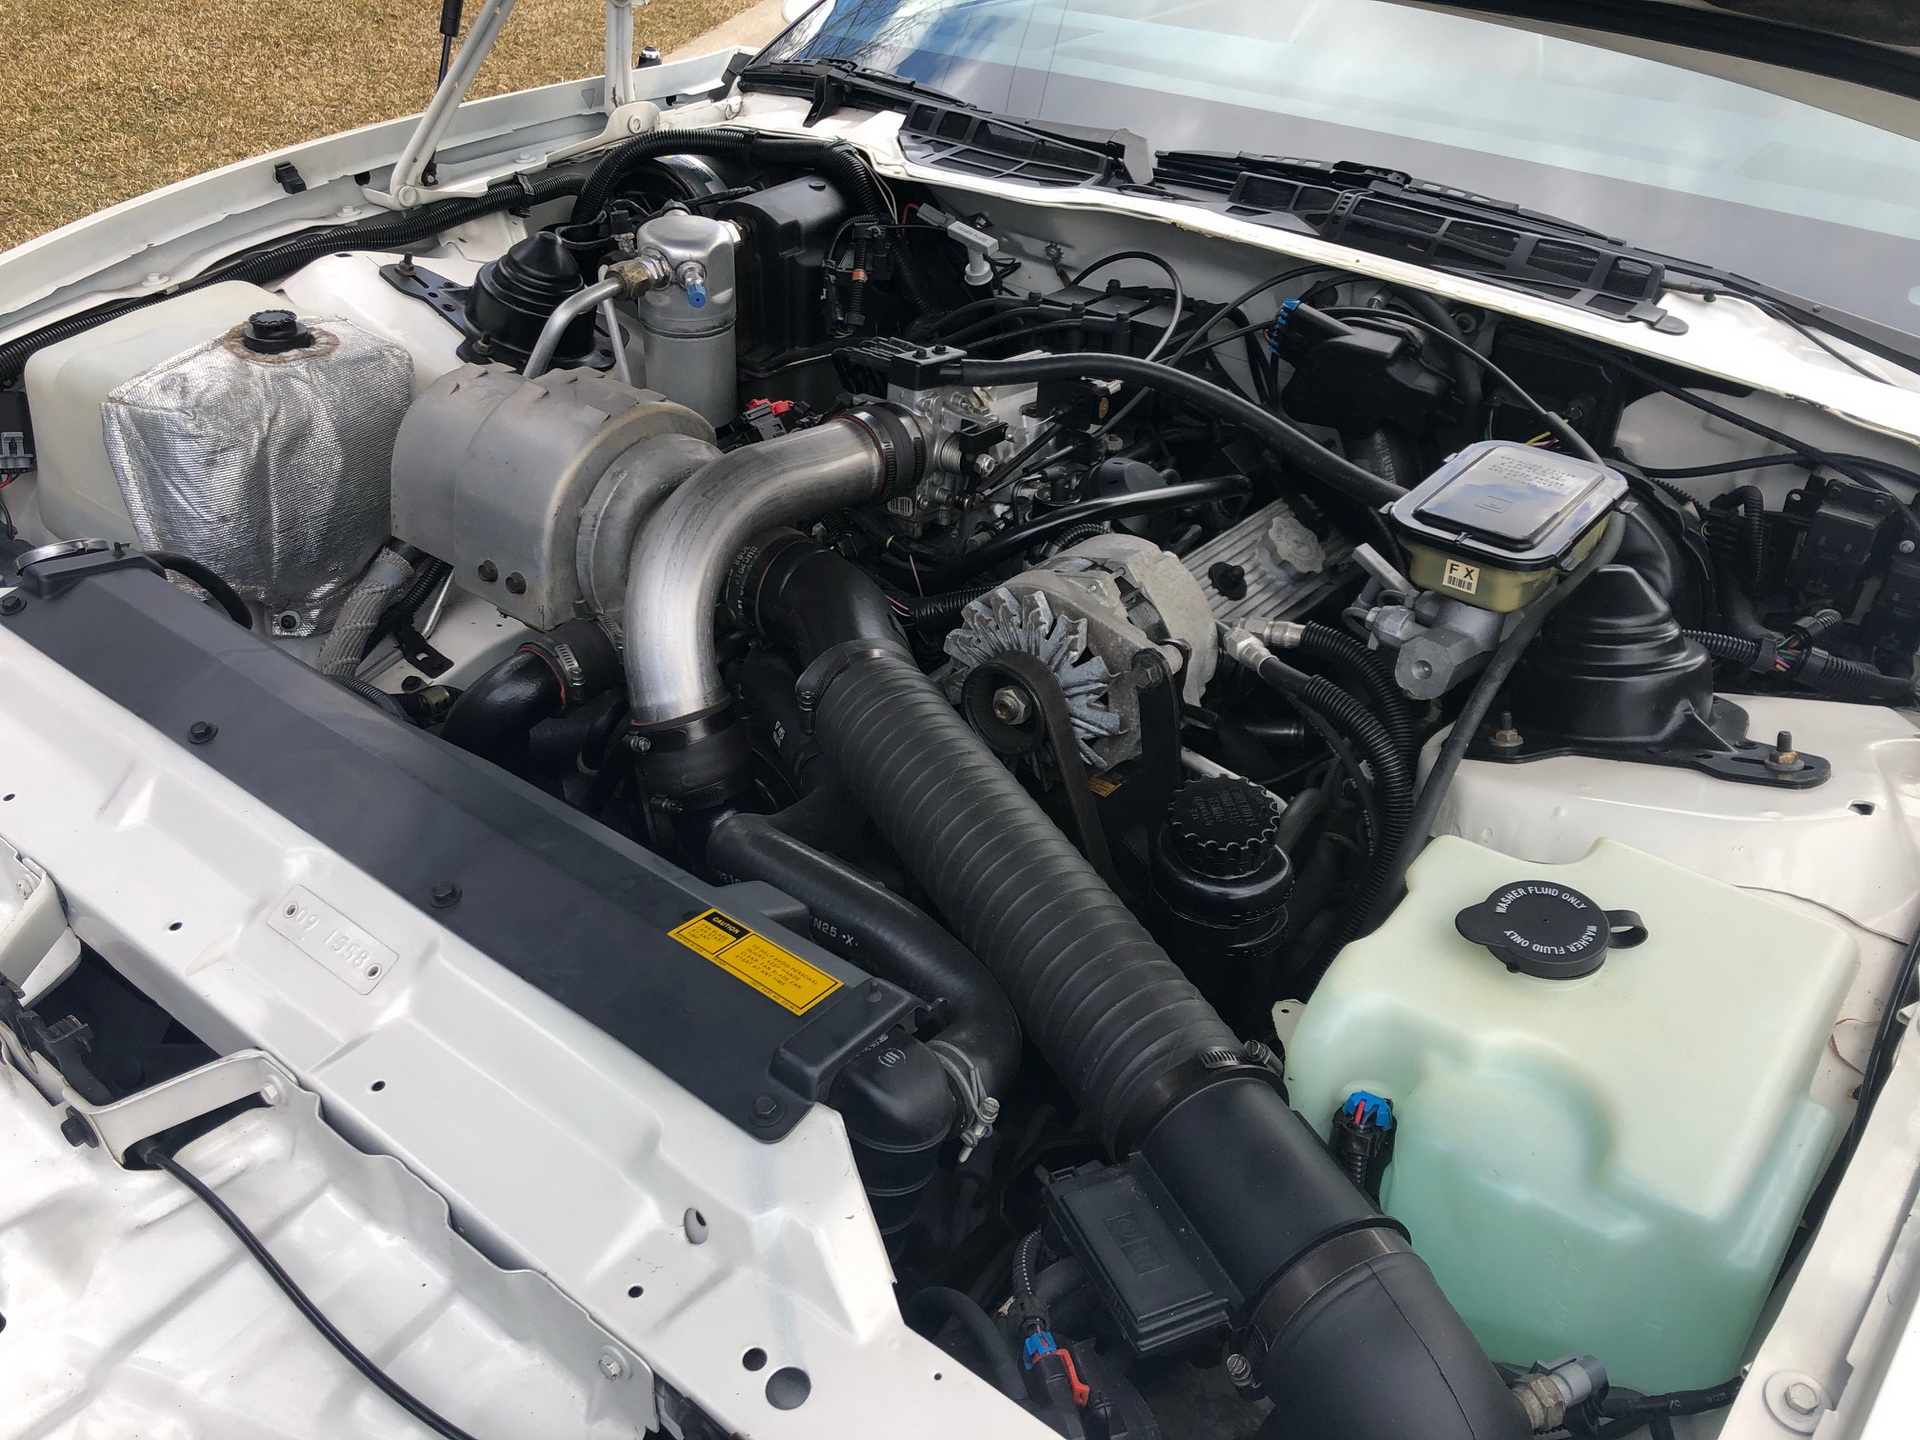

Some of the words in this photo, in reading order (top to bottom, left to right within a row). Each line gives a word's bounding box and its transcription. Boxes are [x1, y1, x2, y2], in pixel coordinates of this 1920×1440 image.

[1496, 888, 1526, 914] WASHER
[1528, 887, 1559, 896] FLUID
[1562, 893, 1587, 910] ONLY
[294, 907, 320, 931] 09
[712, 916, 741, 935] CAUTION
[814, 918, 837, 937] N25
[686, 931, 700, 939] TIME
[697, 932, 711, 940] ANY
[706, 932, 725, 943] START
[711, 929, 729, 940] BLADE
[1504, 930, 1529, 947] ONLY
[1569, 925, 1597, 952] WASHER
[1532, 944, 1565, 955] FLUID
[734, 954, 752, 965] START
[759, 969, 772, 977] ANY
[771, 976, 786, 986] TIME
[758, 948, 775, 958] HELP
[772, 956, 791, 968] AVOID
[789, 966, 819, 985] PERSONAL
[758, 962, 772, 971] FAN
[770, 969, 789, 981] BLADE
[788, 980, 803, 989] CAN
[765, 959, 781, 969] KEEP
[779, 968, 801, 981] HANDS
